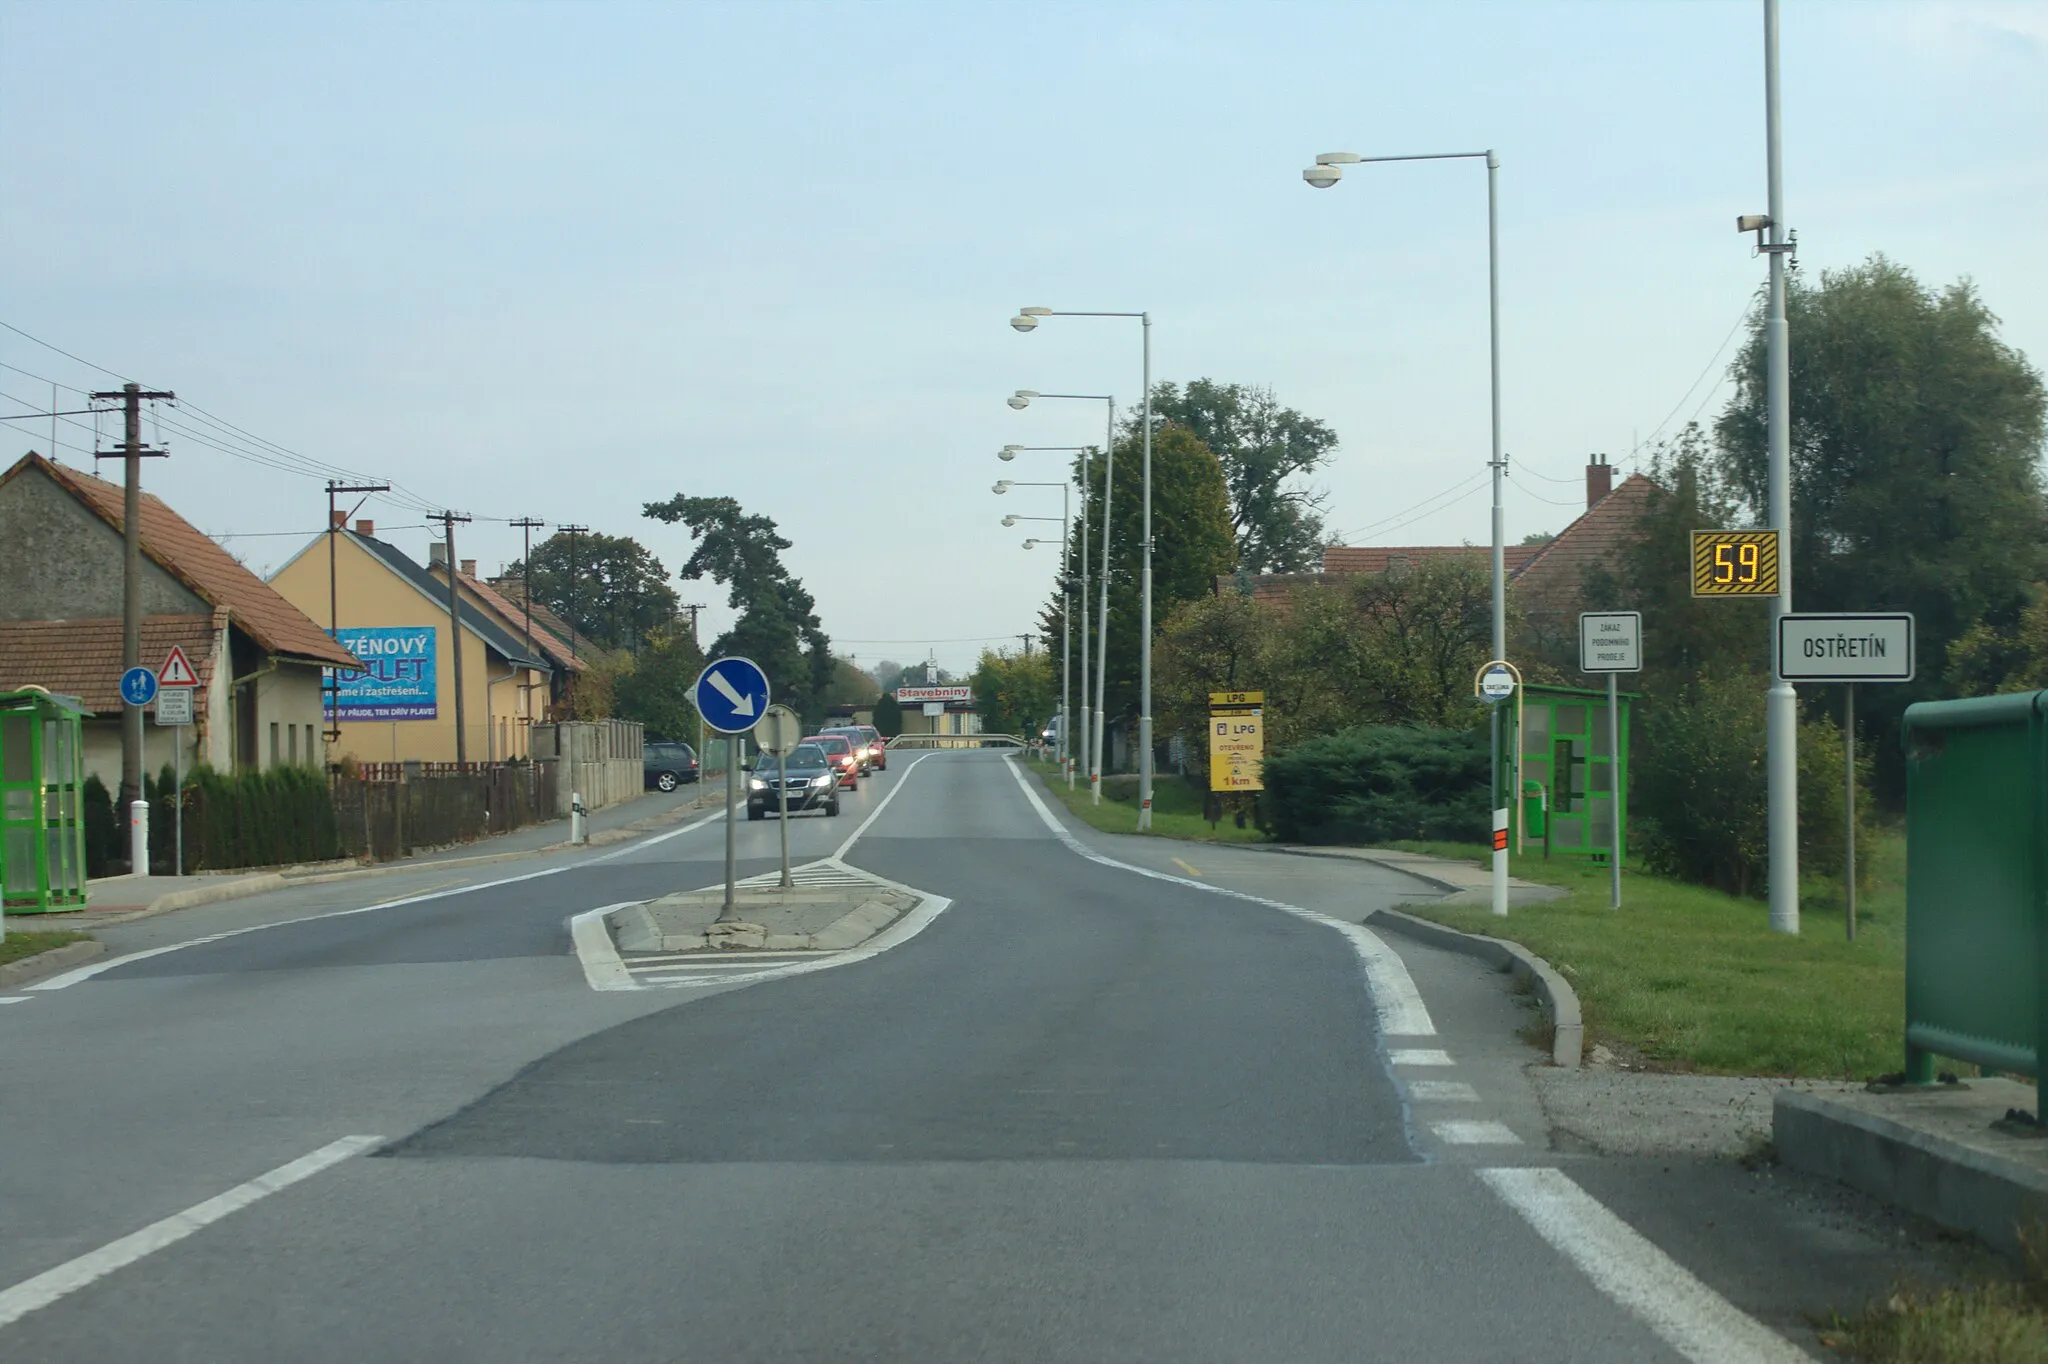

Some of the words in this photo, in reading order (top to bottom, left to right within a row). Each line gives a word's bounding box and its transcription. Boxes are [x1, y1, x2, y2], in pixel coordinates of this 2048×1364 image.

[1714, 544, 1758, 583] 59
[1600, 621, 1621, 632] ZÁKAZ
[1591, 637, 1630, 647] PODOMNÍHO
[1803, 633, 1886, 658] OSTŘETÍN
[1596, 652, 1625, 661] PRODEJE
[898, 687, 969, 697] Stavebniny
[1226, 694, 1246, 703] LPG
[1233, 724, 1256, 734] LPG
